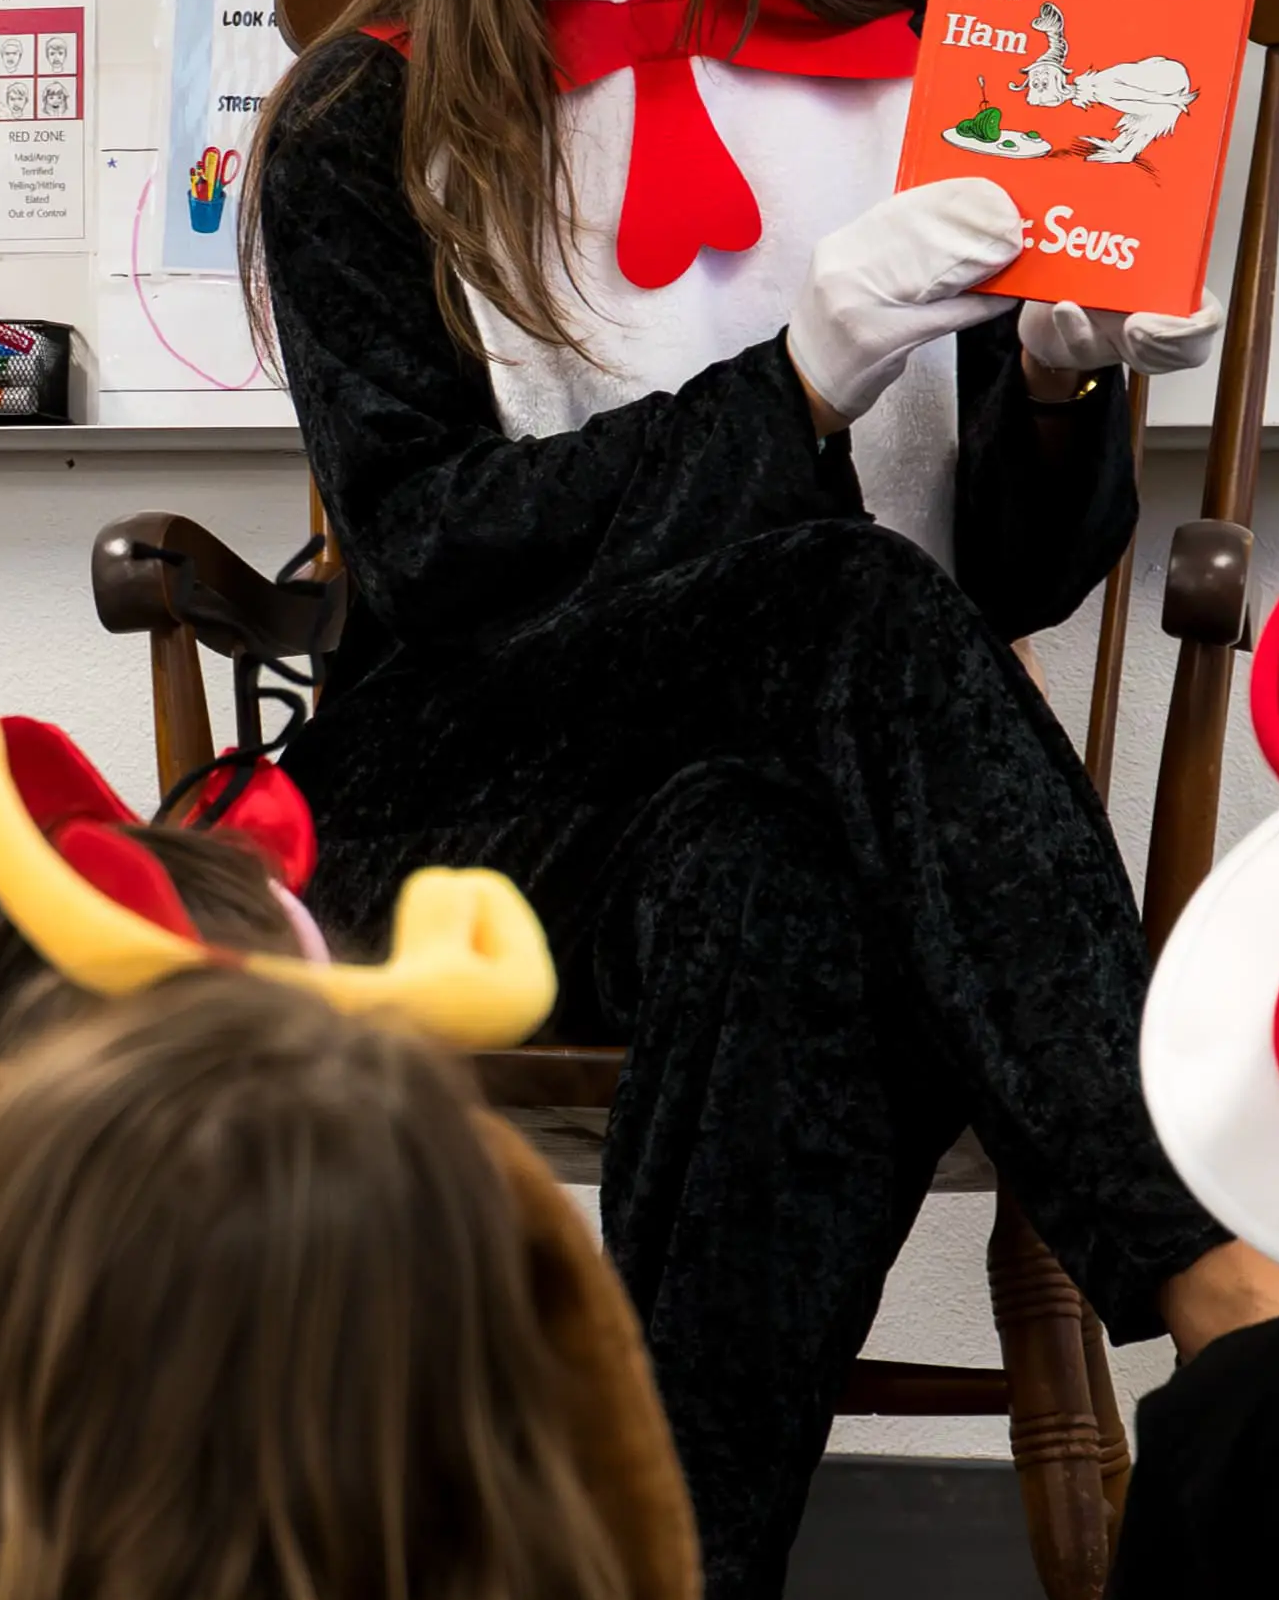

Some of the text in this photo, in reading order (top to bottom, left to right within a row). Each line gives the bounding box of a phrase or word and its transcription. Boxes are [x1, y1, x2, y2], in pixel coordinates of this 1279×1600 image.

[222, 10, 264, 27] LOOK
[940, 12, 1028, 56] Ham
[9, 130, 66, 143] RED ZONE
[14, 153, 60, 165] Mad/Angry
[21, 167, 54, 176] Terrified
[8, 208, 67, 218] Out of Control
[1037, 204, 1141, 272] Seuss
